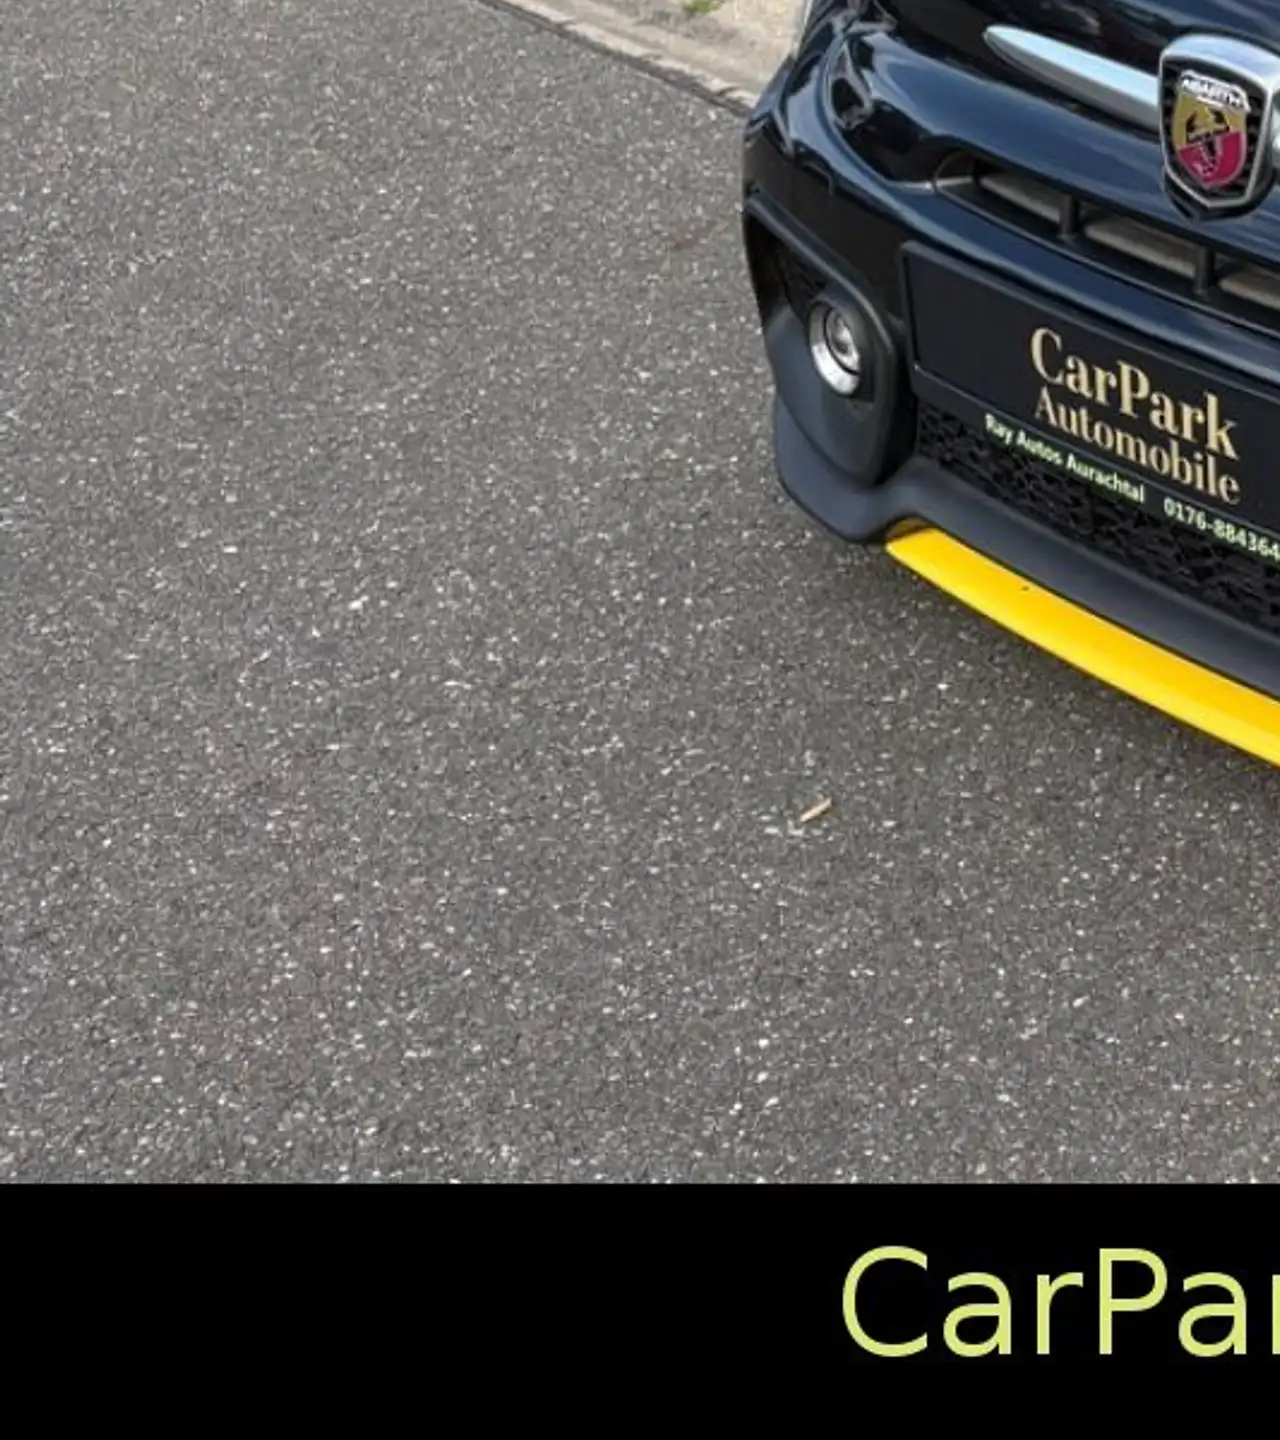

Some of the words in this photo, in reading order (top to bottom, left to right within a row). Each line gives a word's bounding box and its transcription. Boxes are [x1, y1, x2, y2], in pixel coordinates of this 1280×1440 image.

[1030, 326, 1240, 461] CarPark
[1034, 385, 1241, 505] Automobile
[983, 411, 1013, 445] Ray
[1015, 430, 1064, 465] Autos
[1066, 452, 1146, 504] Aurachtal
